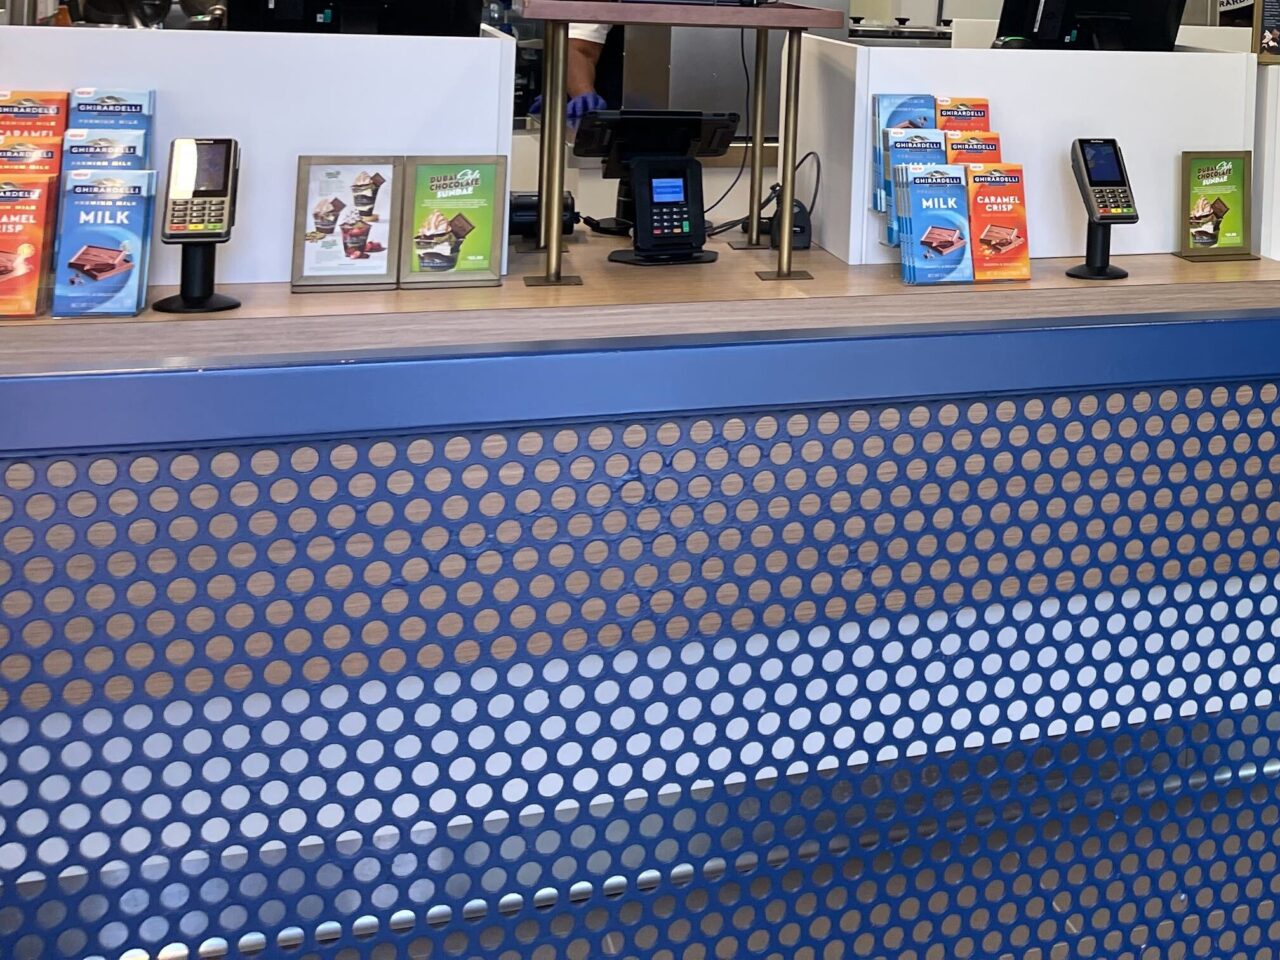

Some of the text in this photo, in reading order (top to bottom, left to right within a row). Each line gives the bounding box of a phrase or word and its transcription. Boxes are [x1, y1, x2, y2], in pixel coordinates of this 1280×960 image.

[79, 104, 141, 112] GHIRARDELLI
[71, 146, 135, 154] GHIRARDELLI
[429, 178, 480, 192] CHOCOLATE
[922, 197, 958, 209] MILK
[976, 195, 1021, 204] CARAMEL
[985, 204, 1013, 212] CRISP
[79, 210, 131, 225] MILK
